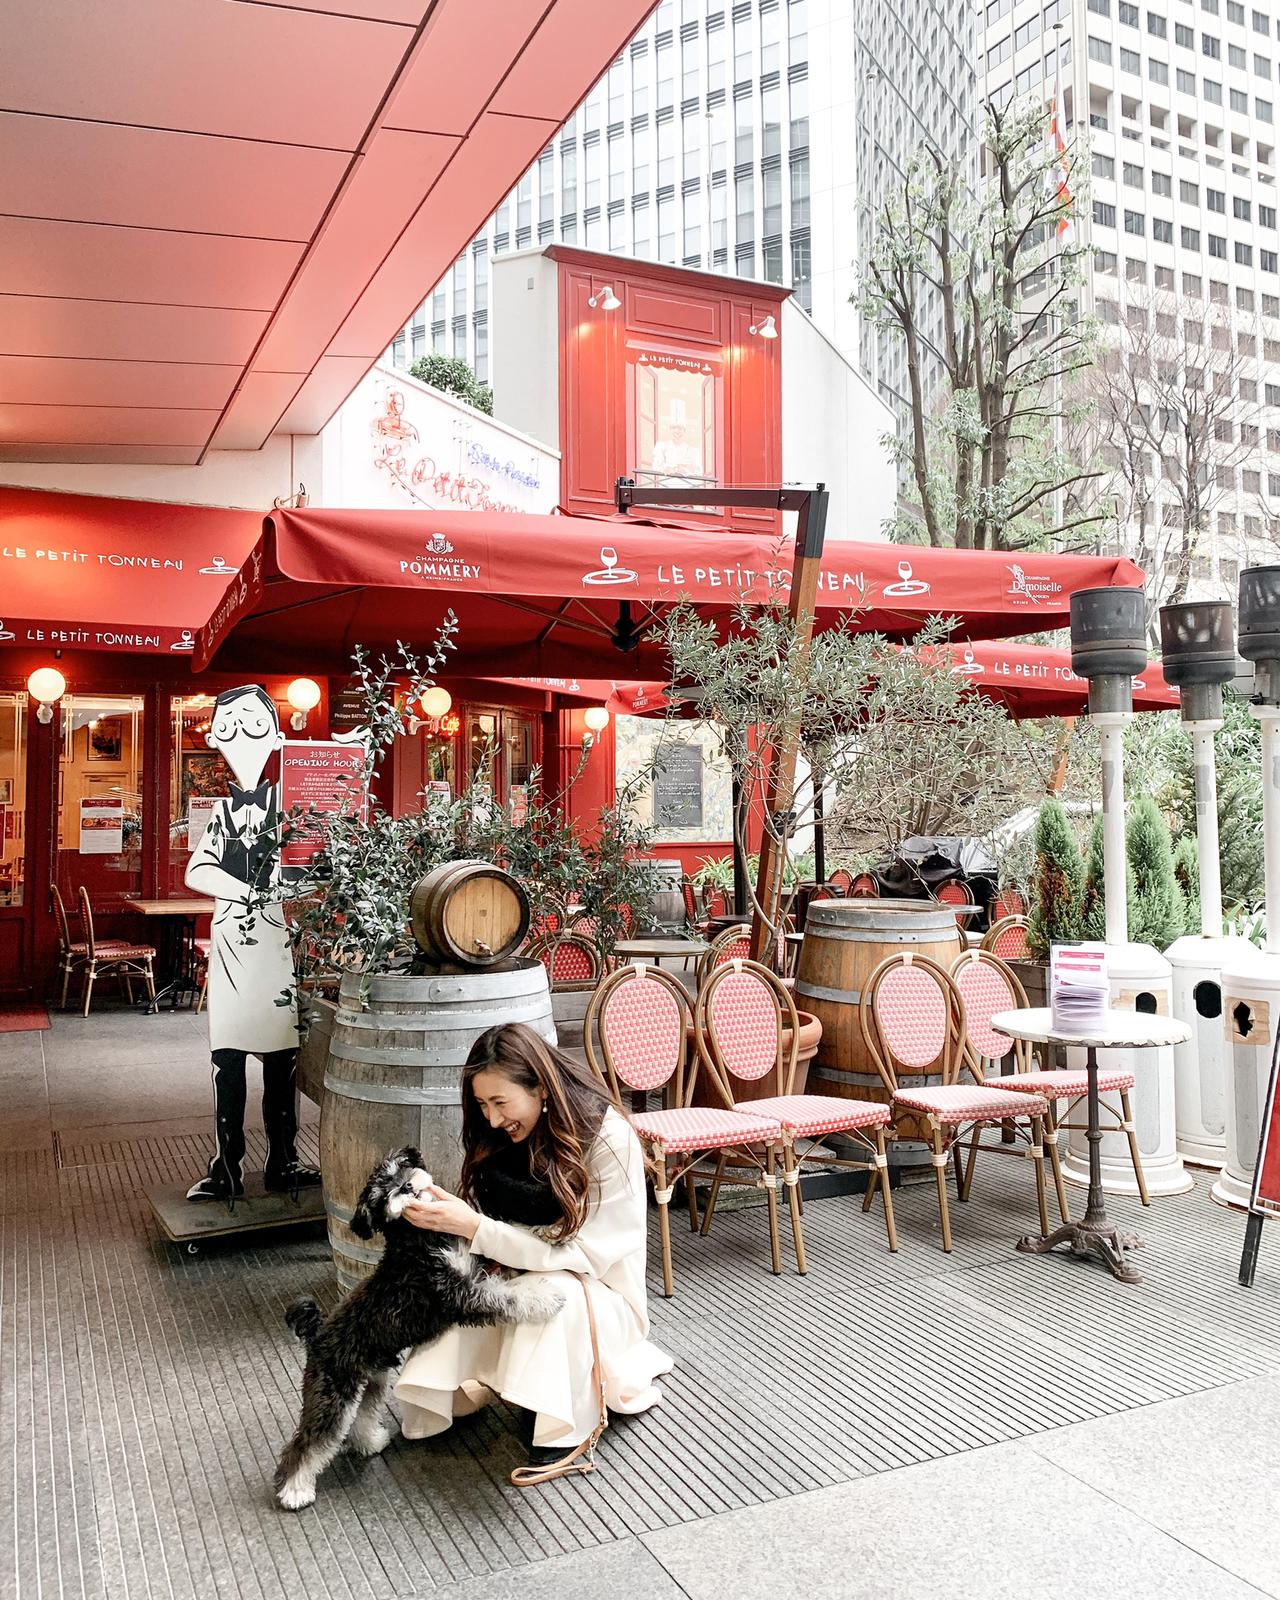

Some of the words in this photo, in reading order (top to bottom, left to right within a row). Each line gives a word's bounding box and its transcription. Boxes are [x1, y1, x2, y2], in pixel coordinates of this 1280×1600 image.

[3, 547, 27, 559] LE
[35, 549, 89, 563] PETIT
[97, 554, 183, 571] TONNEAU
[415, 555, 465, 564] CHAMPAGNE
[400, 560, 480, 579] POMMERY
[658, 564, 685, 585] LE
[695, 562, 755, 587] PETIT
[1012, 580, 1062, 592] Demoiselle
[27, 628, 45, 641] LE
[51, 627, 89, 643] PETIT
[95, 633, 160, 647] TONNEAU
[994, 662, 1010, 675] LE
[1015, 660, 1050, 678] PETIT
[284, 758, 330, 767] OPENING
[309, 750, 341, 759] お知らせ
